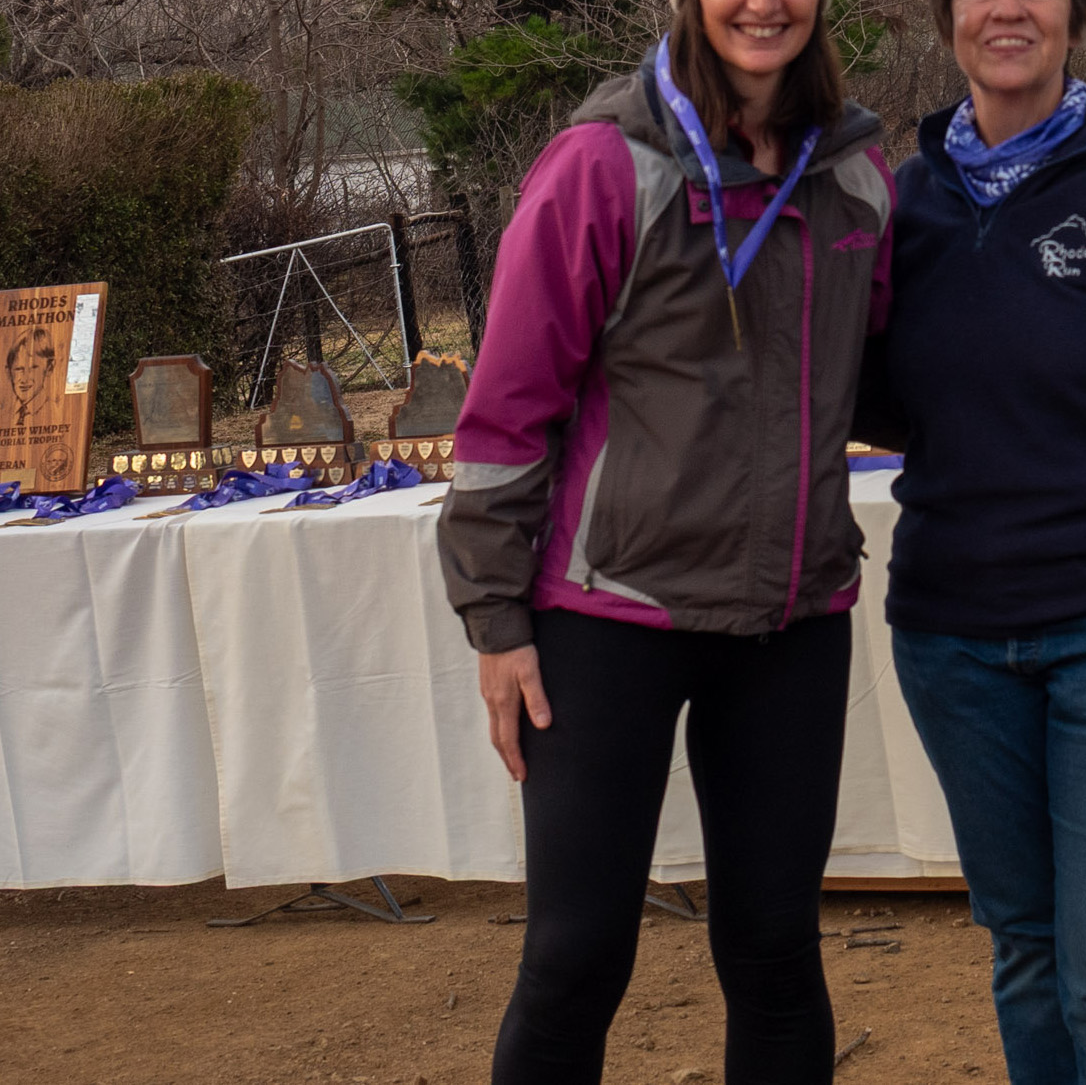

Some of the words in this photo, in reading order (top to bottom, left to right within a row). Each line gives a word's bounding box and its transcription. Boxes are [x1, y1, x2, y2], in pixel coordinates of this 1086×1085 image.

[1043, 258, 1081, 278] Run
[8, 295, 68, 312] RHODES
[29, 424, 71, 435] WIMPEY
[29, 435, 65, 445] TROPHY
